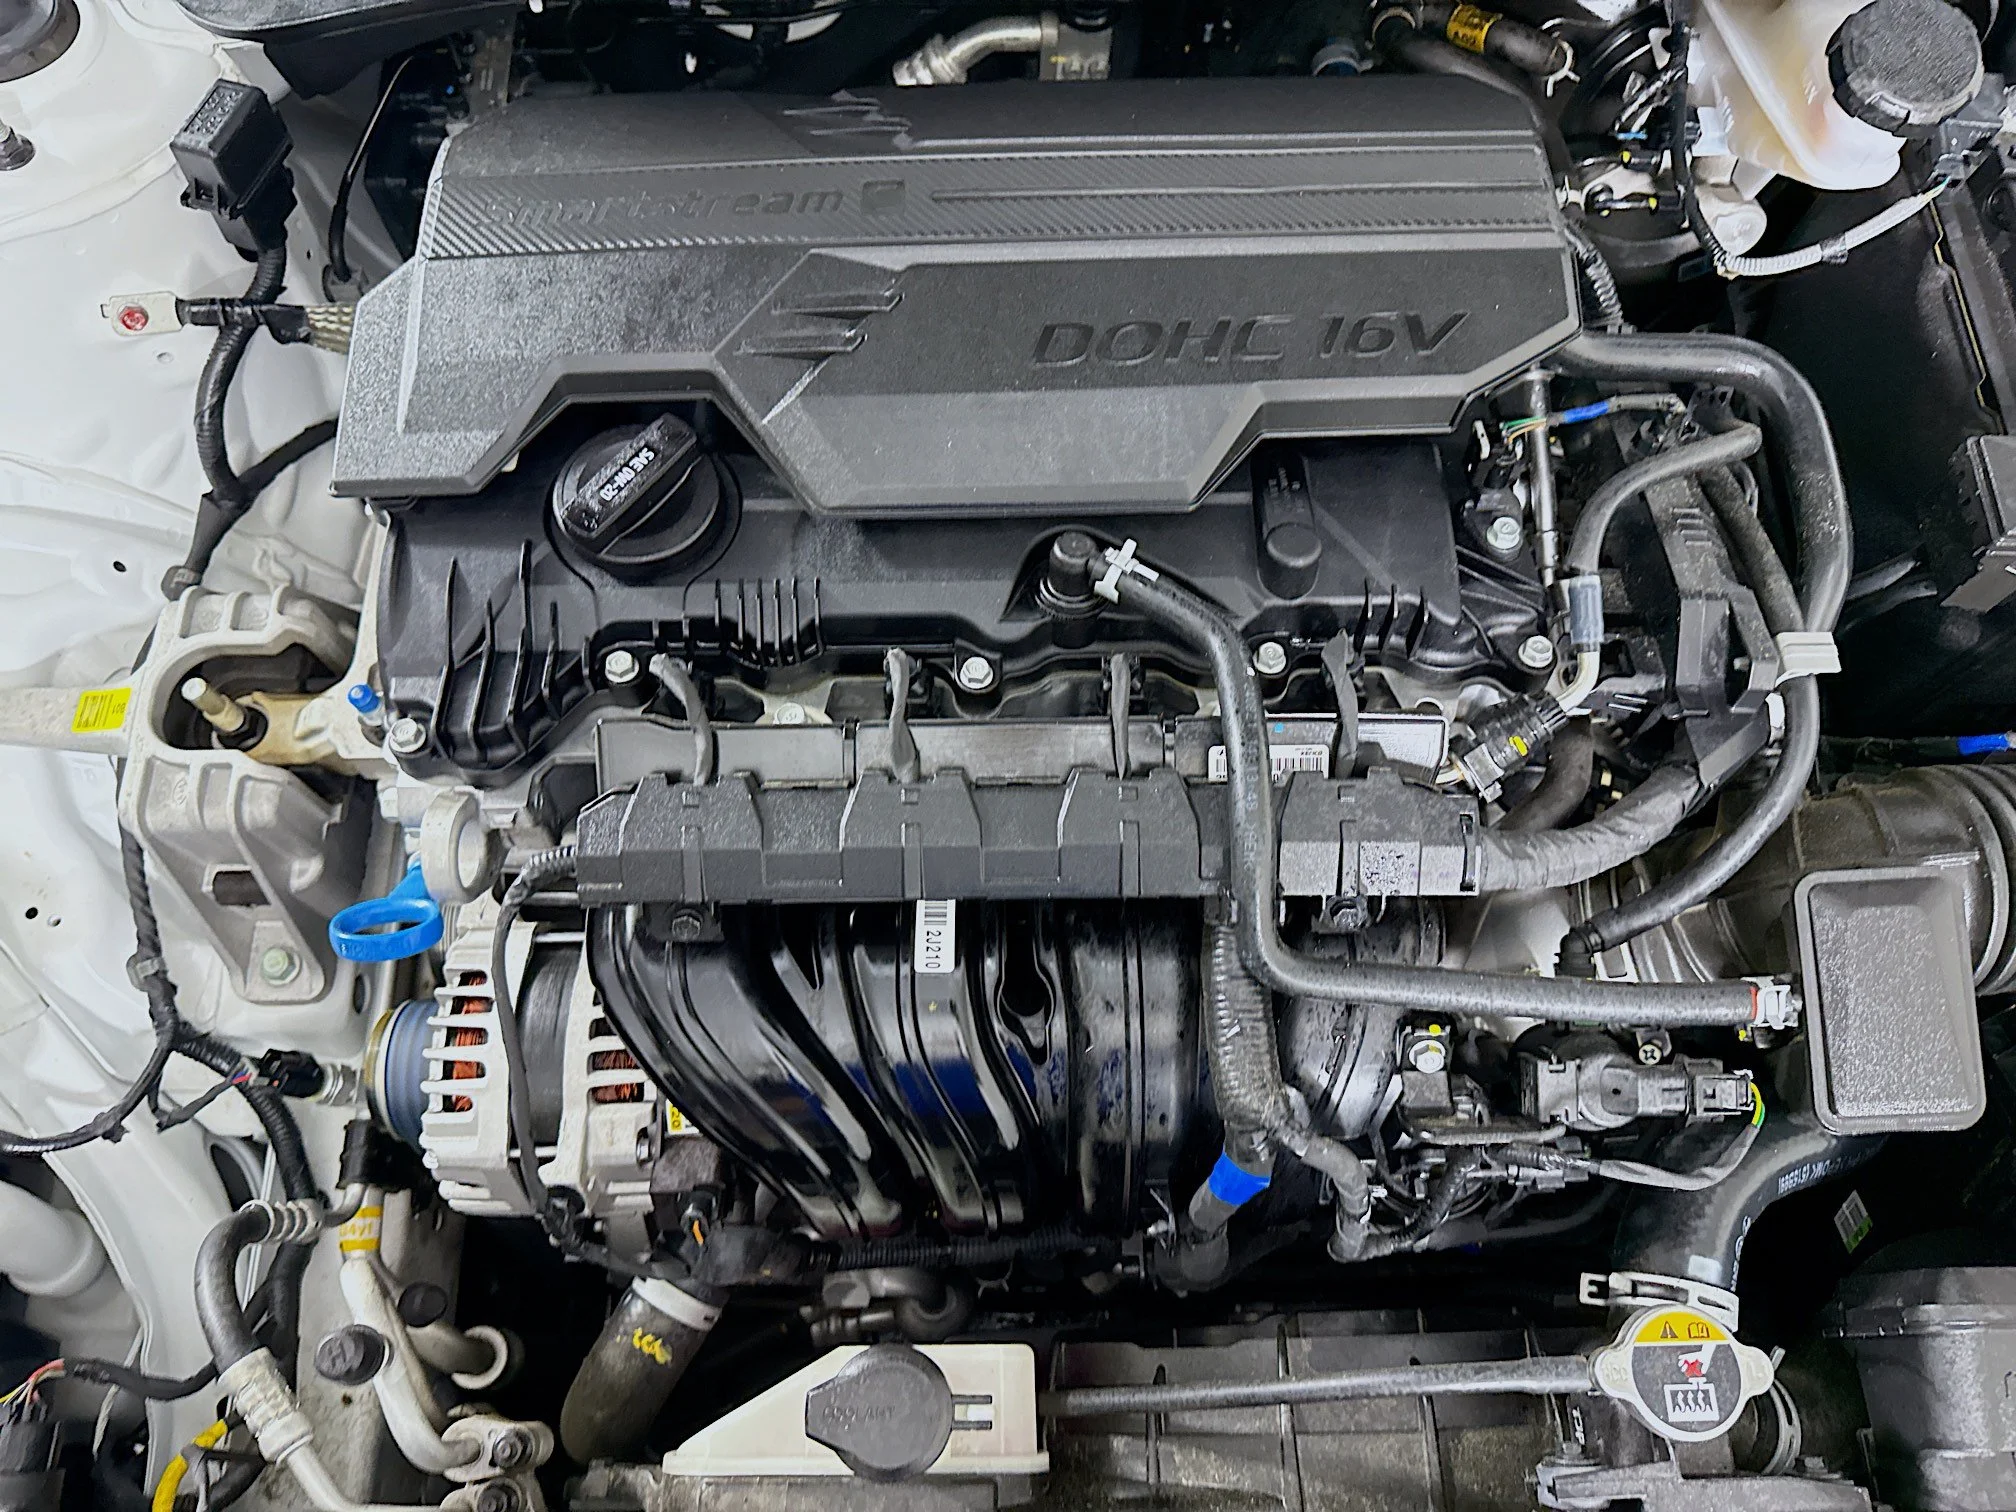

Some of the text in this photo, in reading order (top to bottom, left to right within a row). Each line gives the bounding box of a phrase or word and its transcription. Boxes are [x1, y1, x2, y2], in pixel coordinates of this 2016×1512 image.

[1032, 310, 1471, 367] DOHC 16V
[599, 447, 655, 502] SAE 0W-20
[925, 930, 942, 969] 2J210
